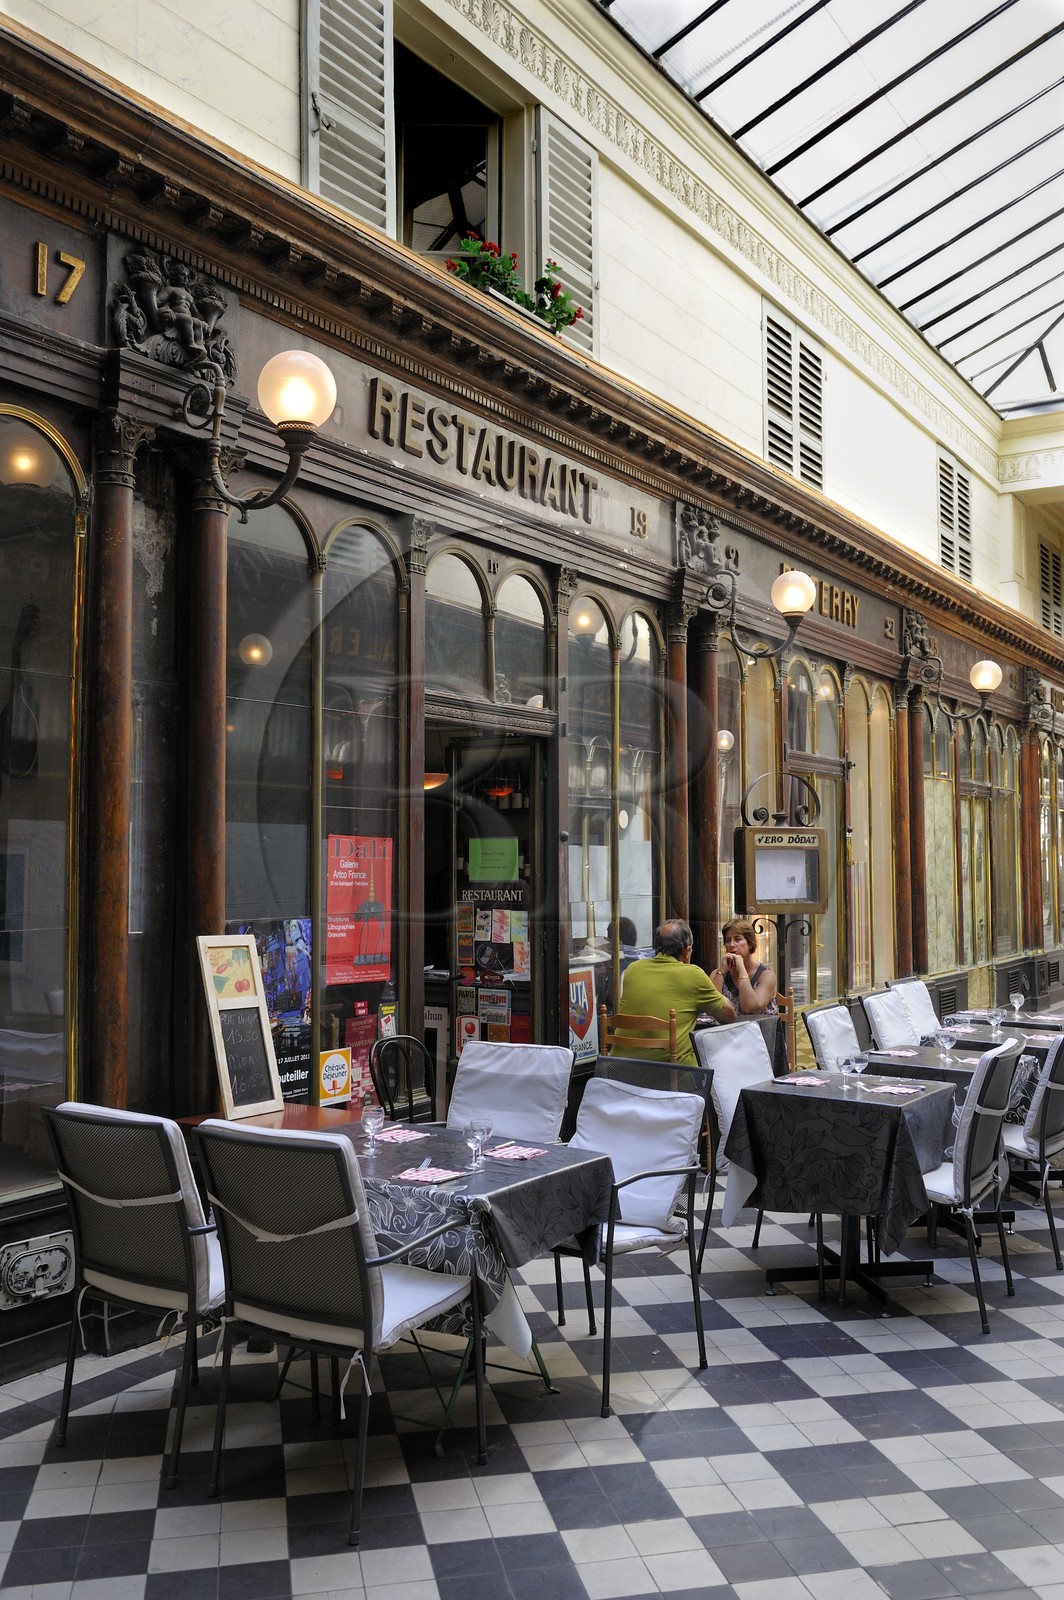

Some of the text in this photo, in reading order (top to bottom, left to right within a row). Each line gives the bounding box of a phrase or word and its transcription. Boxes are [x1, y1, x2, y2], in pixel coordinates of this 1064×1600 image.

[35, 241, 86, 305] 17
[369, 377, 598, 524] RESTAURANT
[630, 506, 647, 539] 19
[757, 835, 783, 844] VERO
[330, 838, 390, 860] Dalí
[340, 859, 359, 869] Galerie
[333, 869, 367, 879] Artco France
[462, 889, 523, 902] RESTAURANT
[571, 1041, 592, 1053] FRANCE
[284, 1055, 300, 1063] JUILLET
[325, 1064, 345, 1072] Chèque
